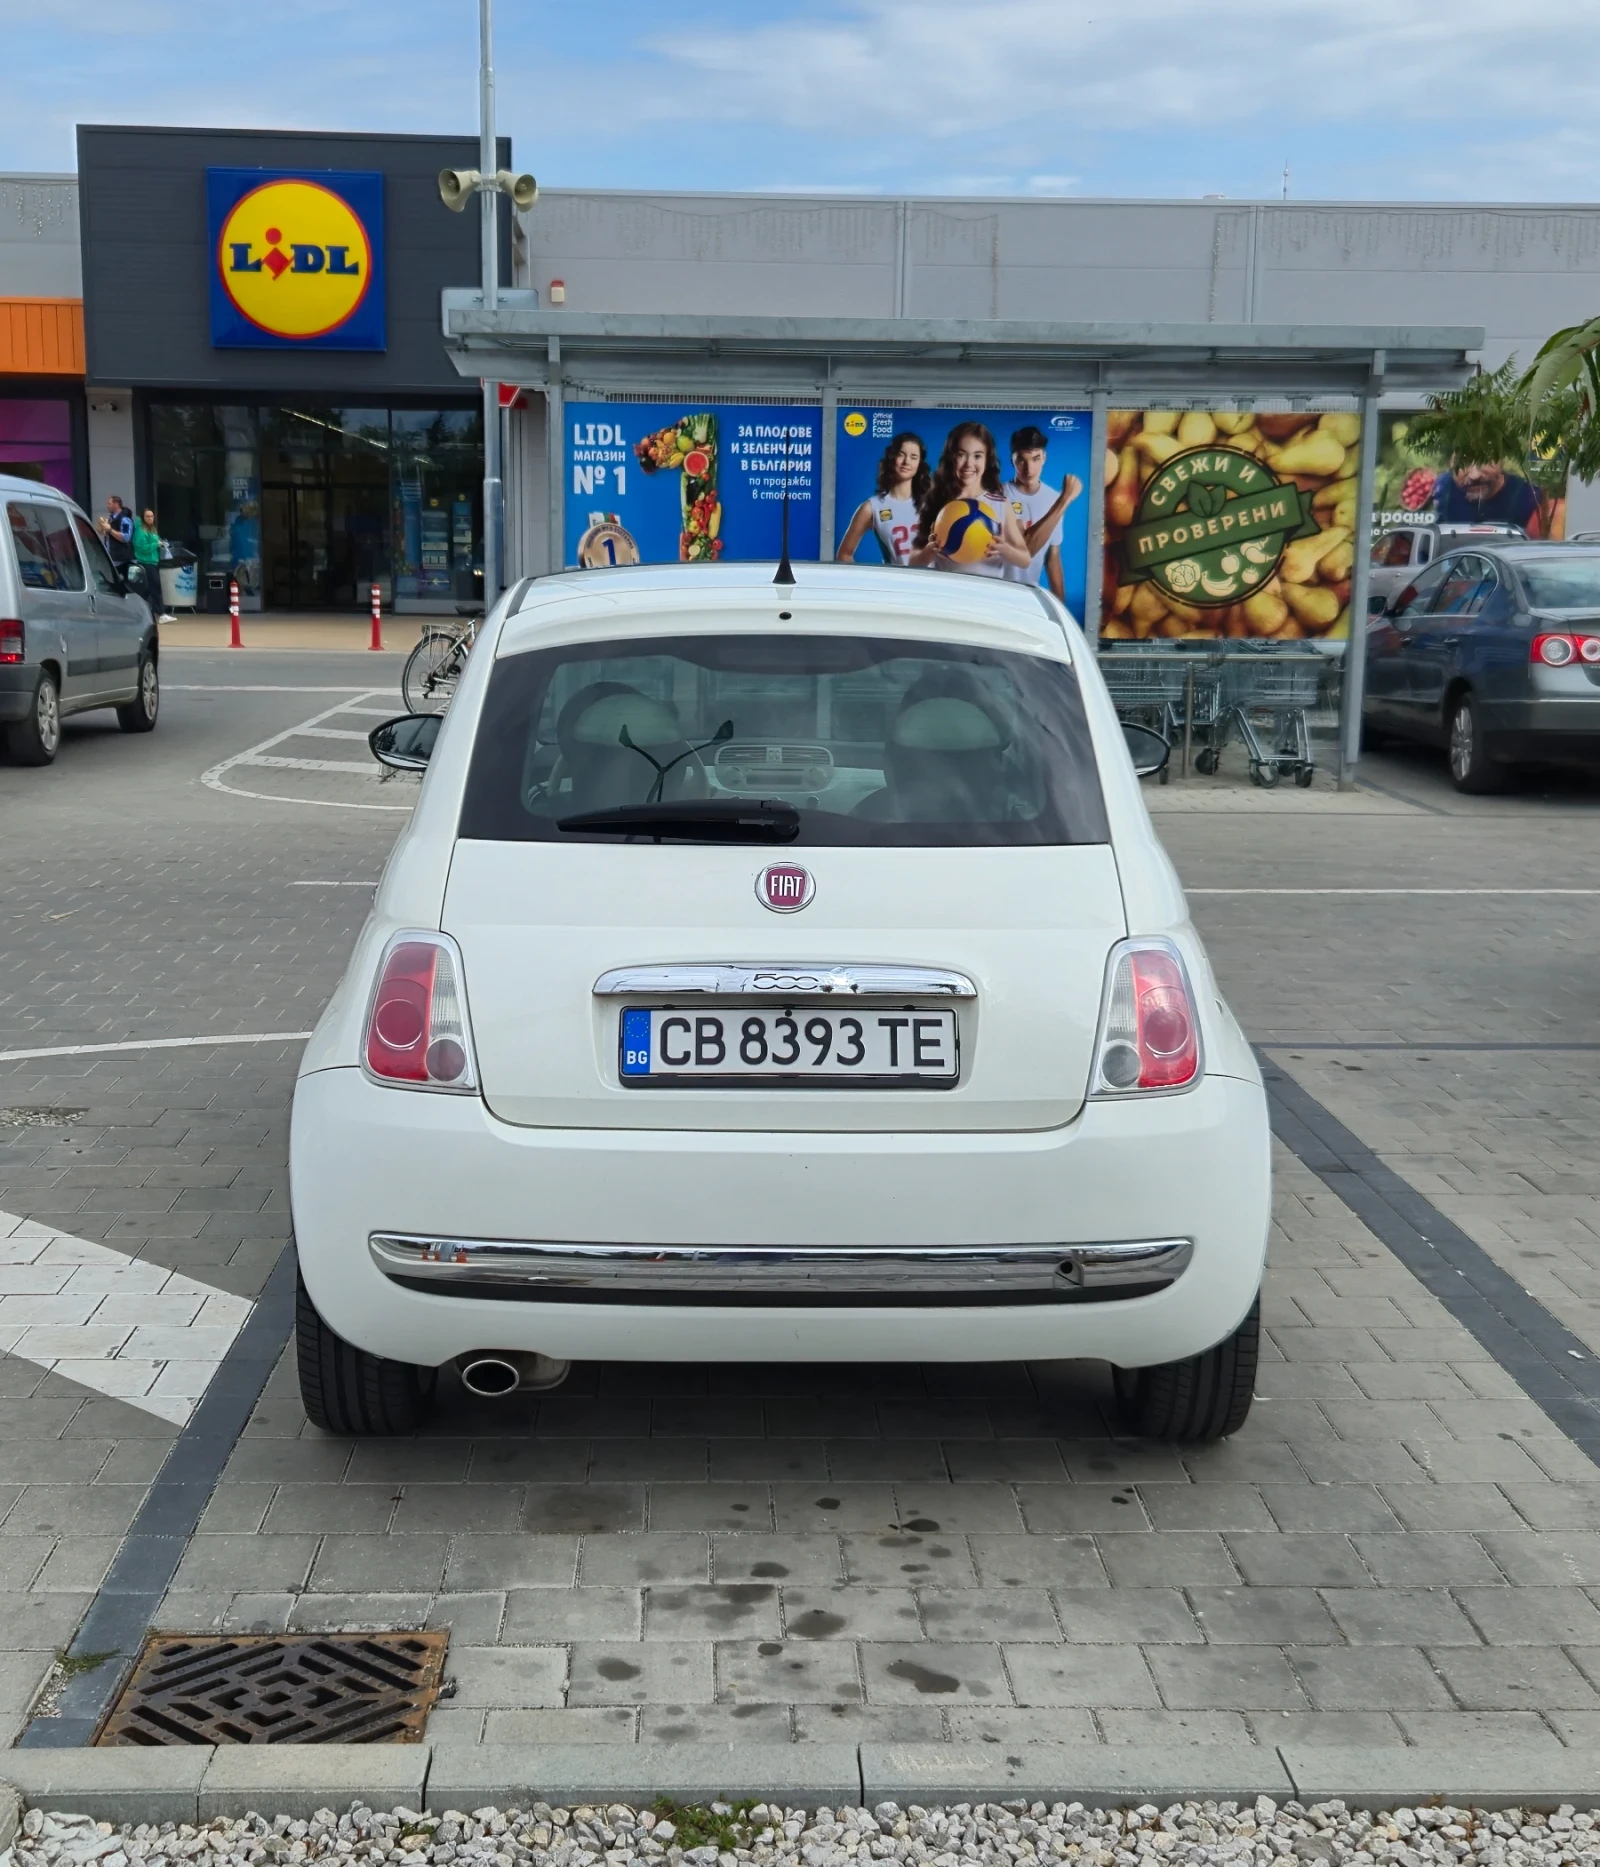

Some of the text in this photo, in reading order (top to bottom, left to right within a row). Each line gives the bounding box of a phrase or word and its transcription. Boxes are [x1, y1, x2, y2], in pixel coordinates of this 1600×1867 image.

[574, 424, 626, 446] LIDL
[738, 425, 812, 440] ЗА ПЛОДОВЕ
[574, 450, 626, 462] МАГАЗИН
[731, 442, 812, 457] И ЗЕЛЕНЧУЦИ
[741, 459, 812, 472] В БЪЛГАРИЯ
[612, 466, 626, 496] 1
[748, 475, 812, 488] по продажби
[1150, 456, 1257, 506] СВЕЖИ И
[752, 489, 758, 500] в
[1138, 501, 1286, 554] ПРОВЕРЕНИ
[771, 875, 803, 898] FIAT
[753, 973, 819, 990] 500
[659, 1016, 945, 1067] CB 8393 TE
[626, 1050, 648, 1066] BG
